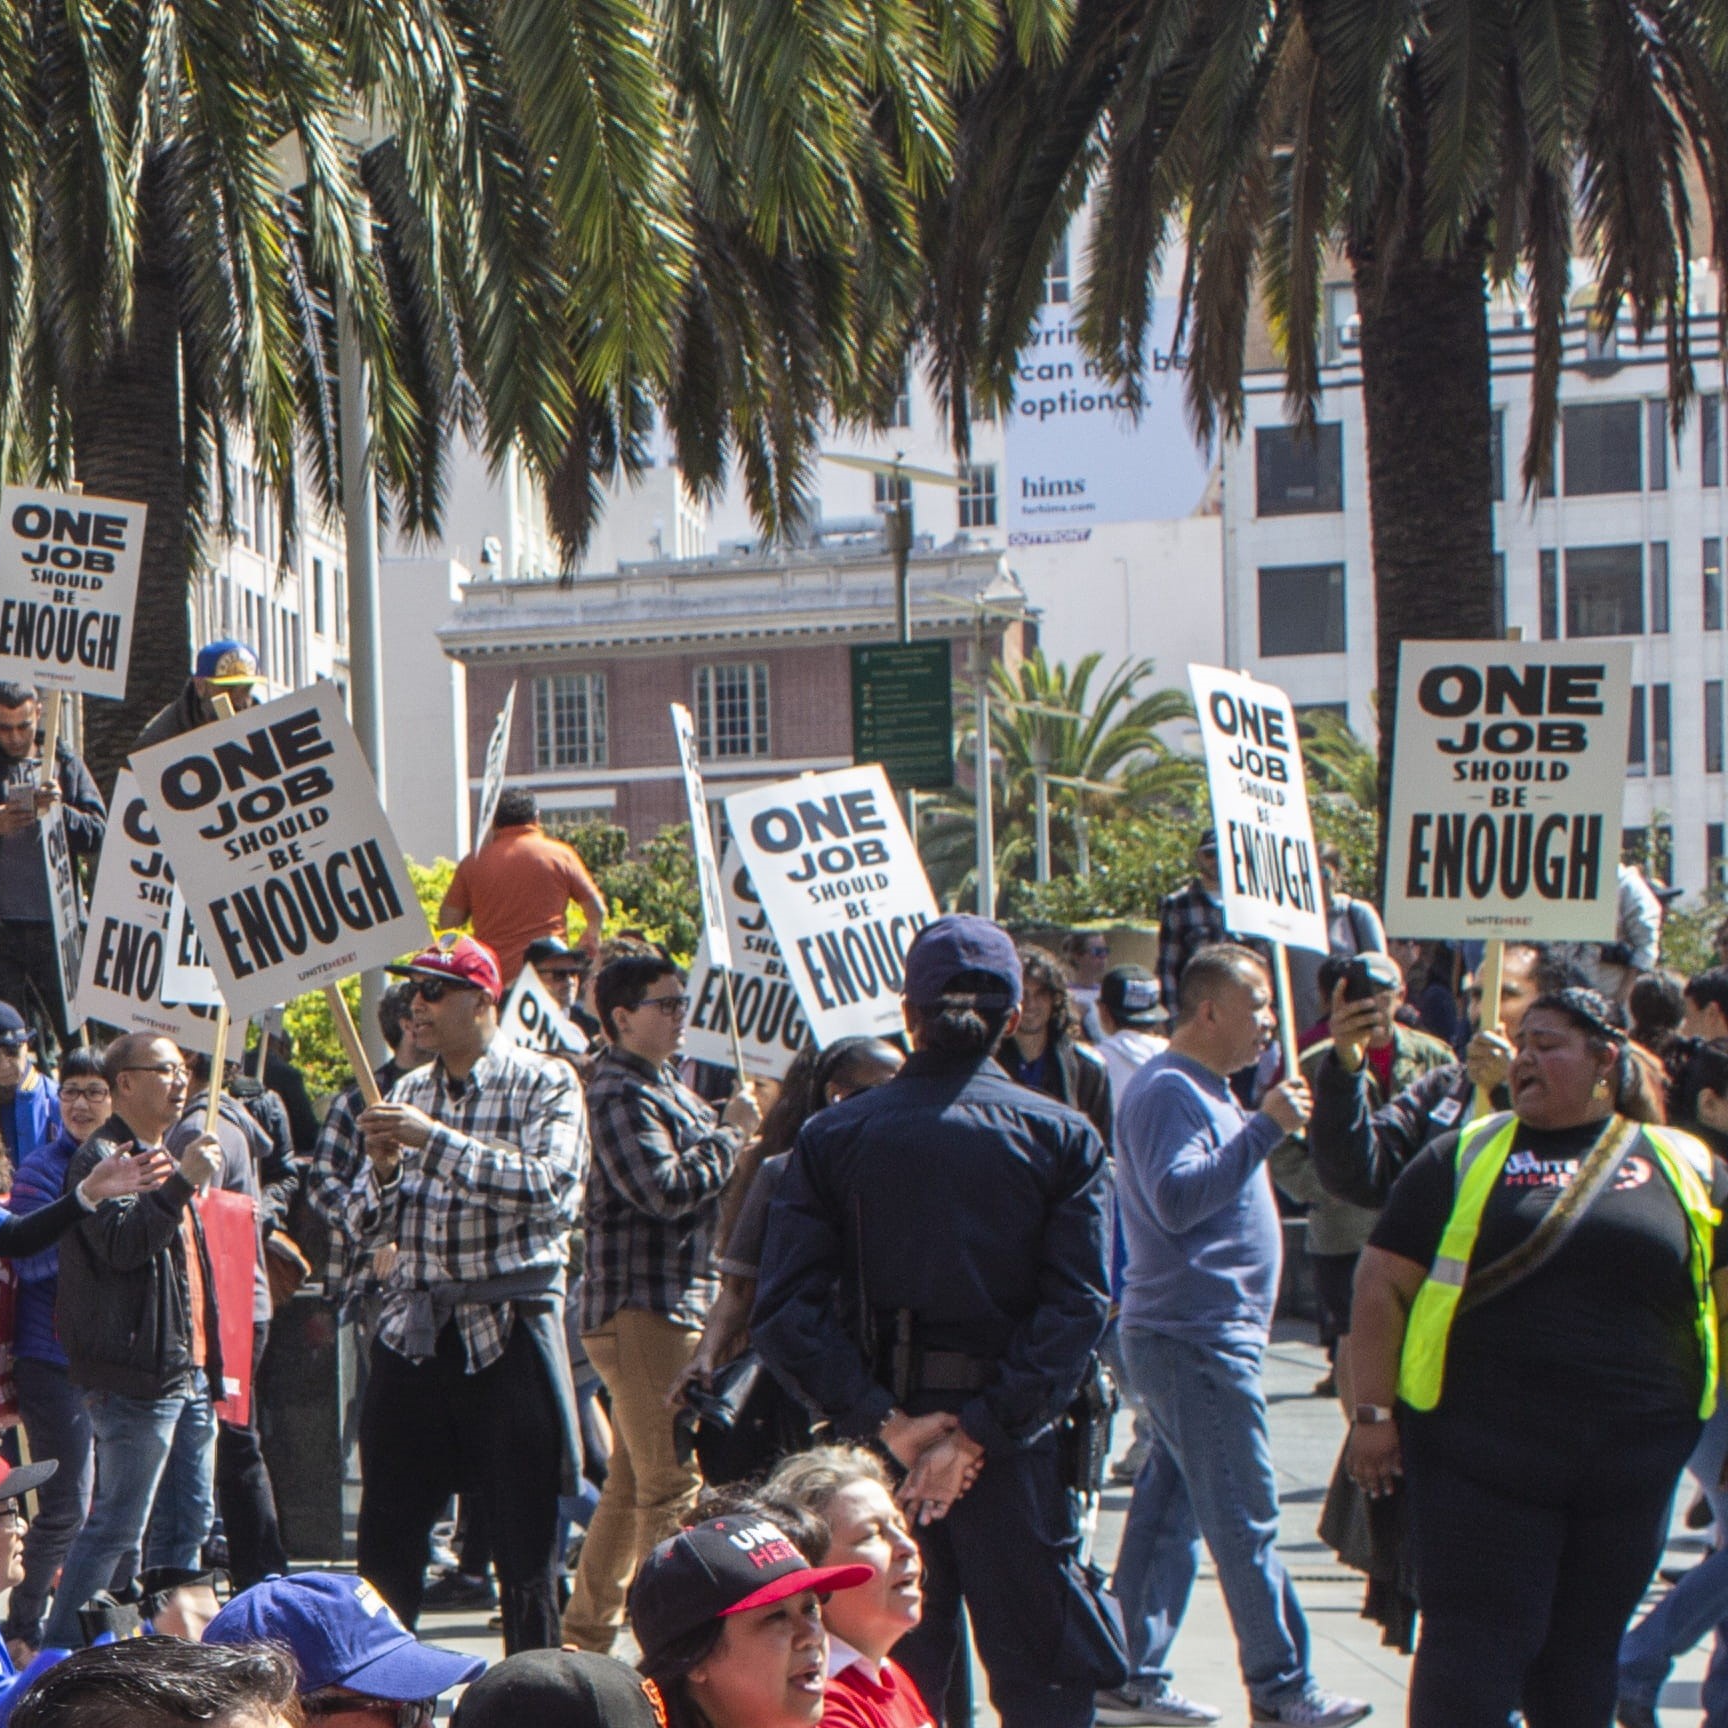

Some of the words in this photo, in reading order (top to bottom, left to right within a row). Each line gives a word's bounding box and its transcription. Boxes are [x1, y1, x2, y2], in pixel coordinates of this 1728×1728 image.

[1019, 361, 1073, 381] can
[1021, 477, 1087, 498] hims
[12, 504, 128, 551] ONE
[21, 544, 116, 573] JOB
[31, 568, 103, 591] SHOULD
[53, 588, 76, 605] BE
[1417, 664, 1606, 718] ONE
[1210, 690, 1290, 754] ONE
[1436, 721, 1587, 754] JOB
[160, 707, 334, 811] ONE
[1228, 743, 1289, 784] JOB
[1453, 760, 1570, 783] SHOULD
[199, 765, 334, 842] JOB
[1239, 777, 1286, 807] SHOULD
[1491, 787, 1527, 808] BE
[751, 789, 887, 856] ONE
[1257, 805, 1271, 824] BE
[223, 806, 330, 863] SHOULD
[267, 842, 305, 871] BE
[787, 837, 890, 884] JOB
[1229, 820, 1316, 916] ENOUGH
[1406, 813, 1603, 900] ENOUGH
[808, 873, 889, 905] SHOULD
[208, 837, 405, 980] ENOUGH
[845, 900, 872, 922] BE
